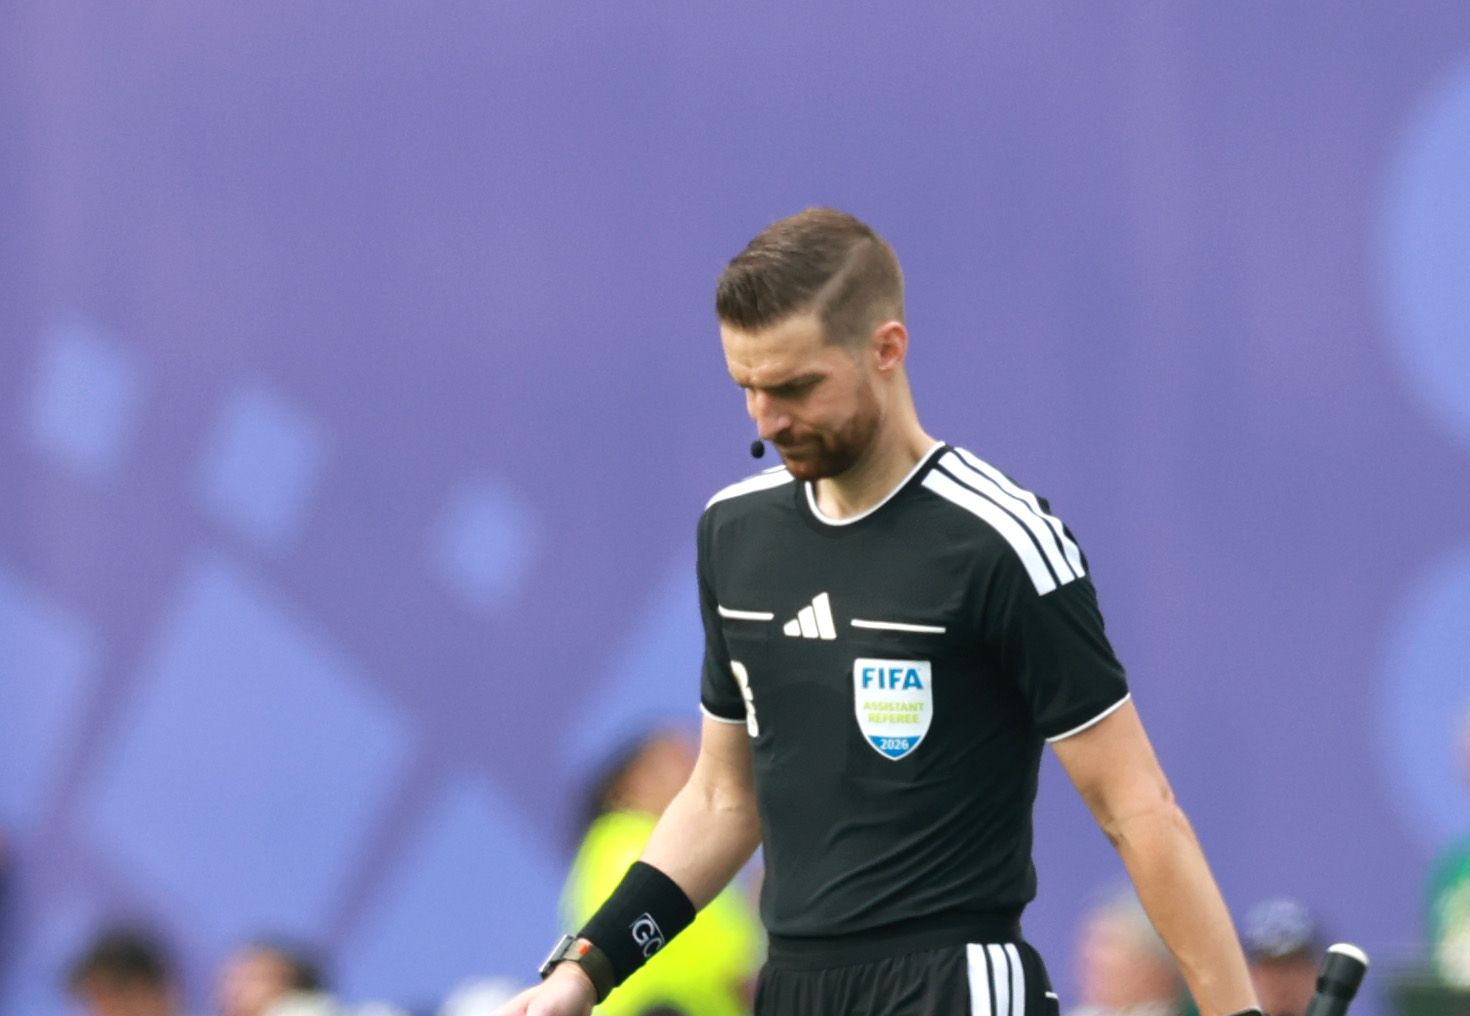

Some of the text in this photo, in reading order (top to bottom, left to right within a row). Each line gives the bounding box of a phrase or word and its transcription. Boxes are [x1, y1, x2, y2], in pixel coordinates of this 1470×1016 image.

[862, 668, 923, 690] FIFA
[863, 701, 924, 712] ASSISTANT
[868, 713, 919, 724] REFEREE
[880, 739, 909, 751] 2026
